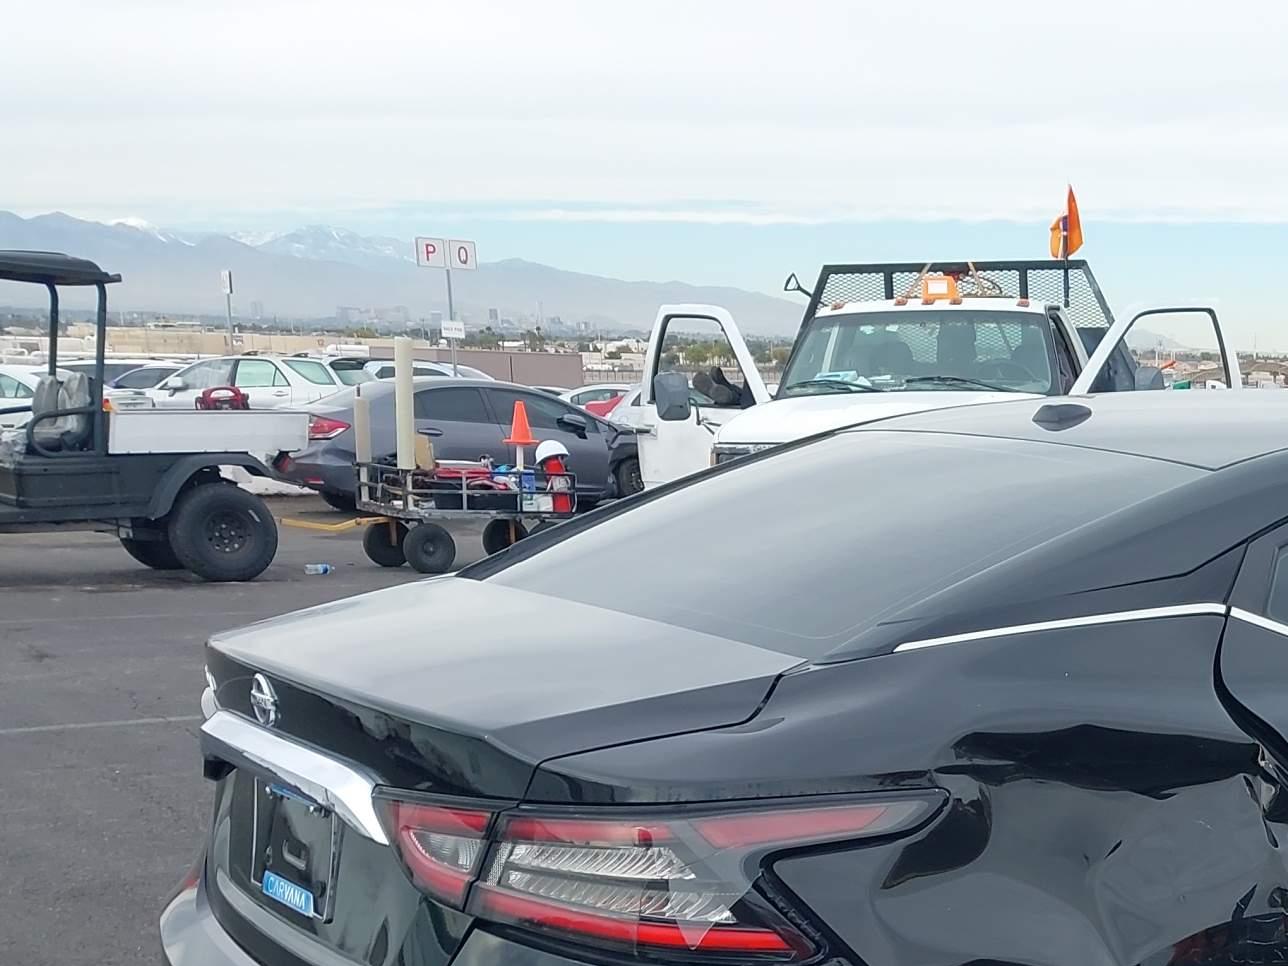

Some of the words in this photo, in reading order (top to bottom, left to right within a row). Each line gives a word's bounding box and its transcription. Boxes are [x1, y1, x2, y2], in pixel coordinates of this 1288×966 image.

[424, 243, 437, 262] P
[457, 246, 469, 265] Q
[267, 876, 307, 911] CARVANA
